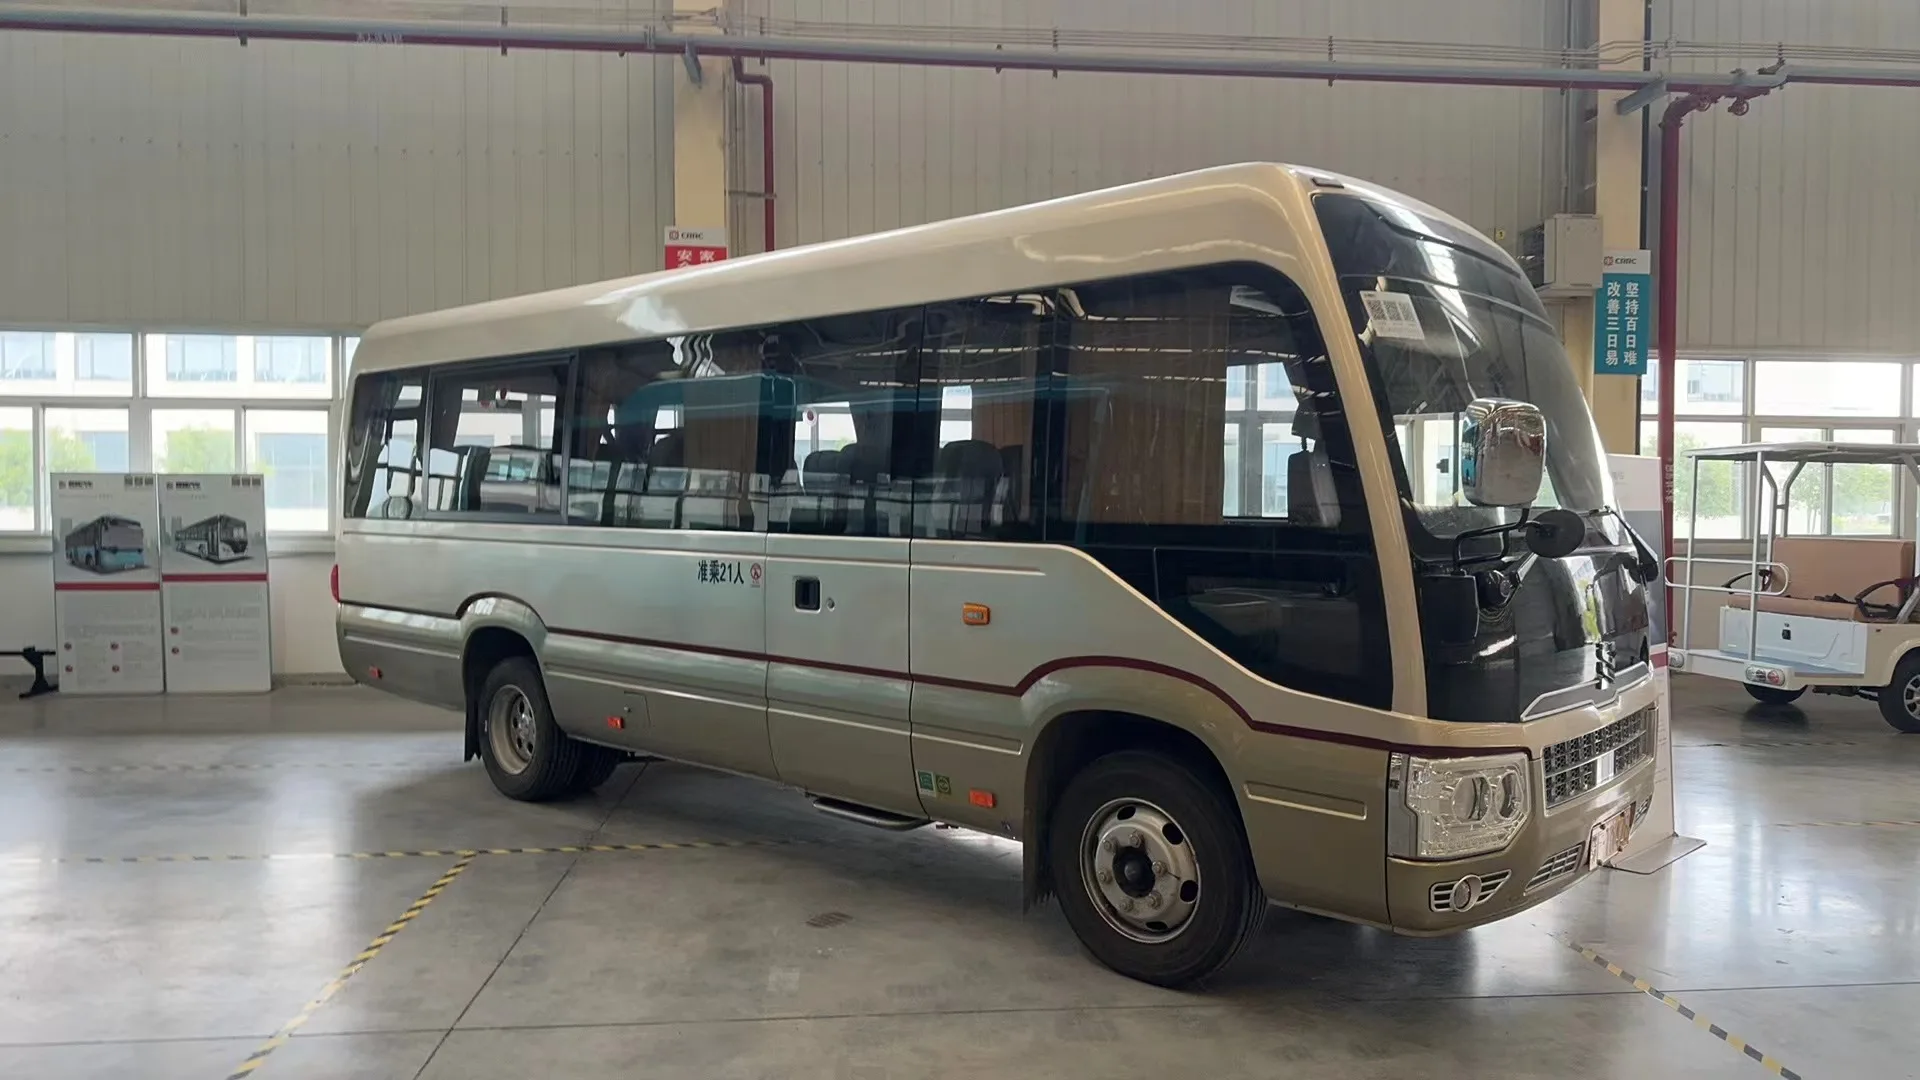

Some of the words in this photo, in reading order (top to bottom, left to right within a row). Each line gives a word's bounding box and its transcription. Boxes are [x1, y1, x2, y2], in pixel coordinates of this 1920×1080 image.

[1614, 257, 1637, 265] CRRC
[1606, 282, 1620, 365] 改善三日易
[1624, 282, 1638, 365] 坚持百日难
[698, 560, 744, 584] 准乘21人
